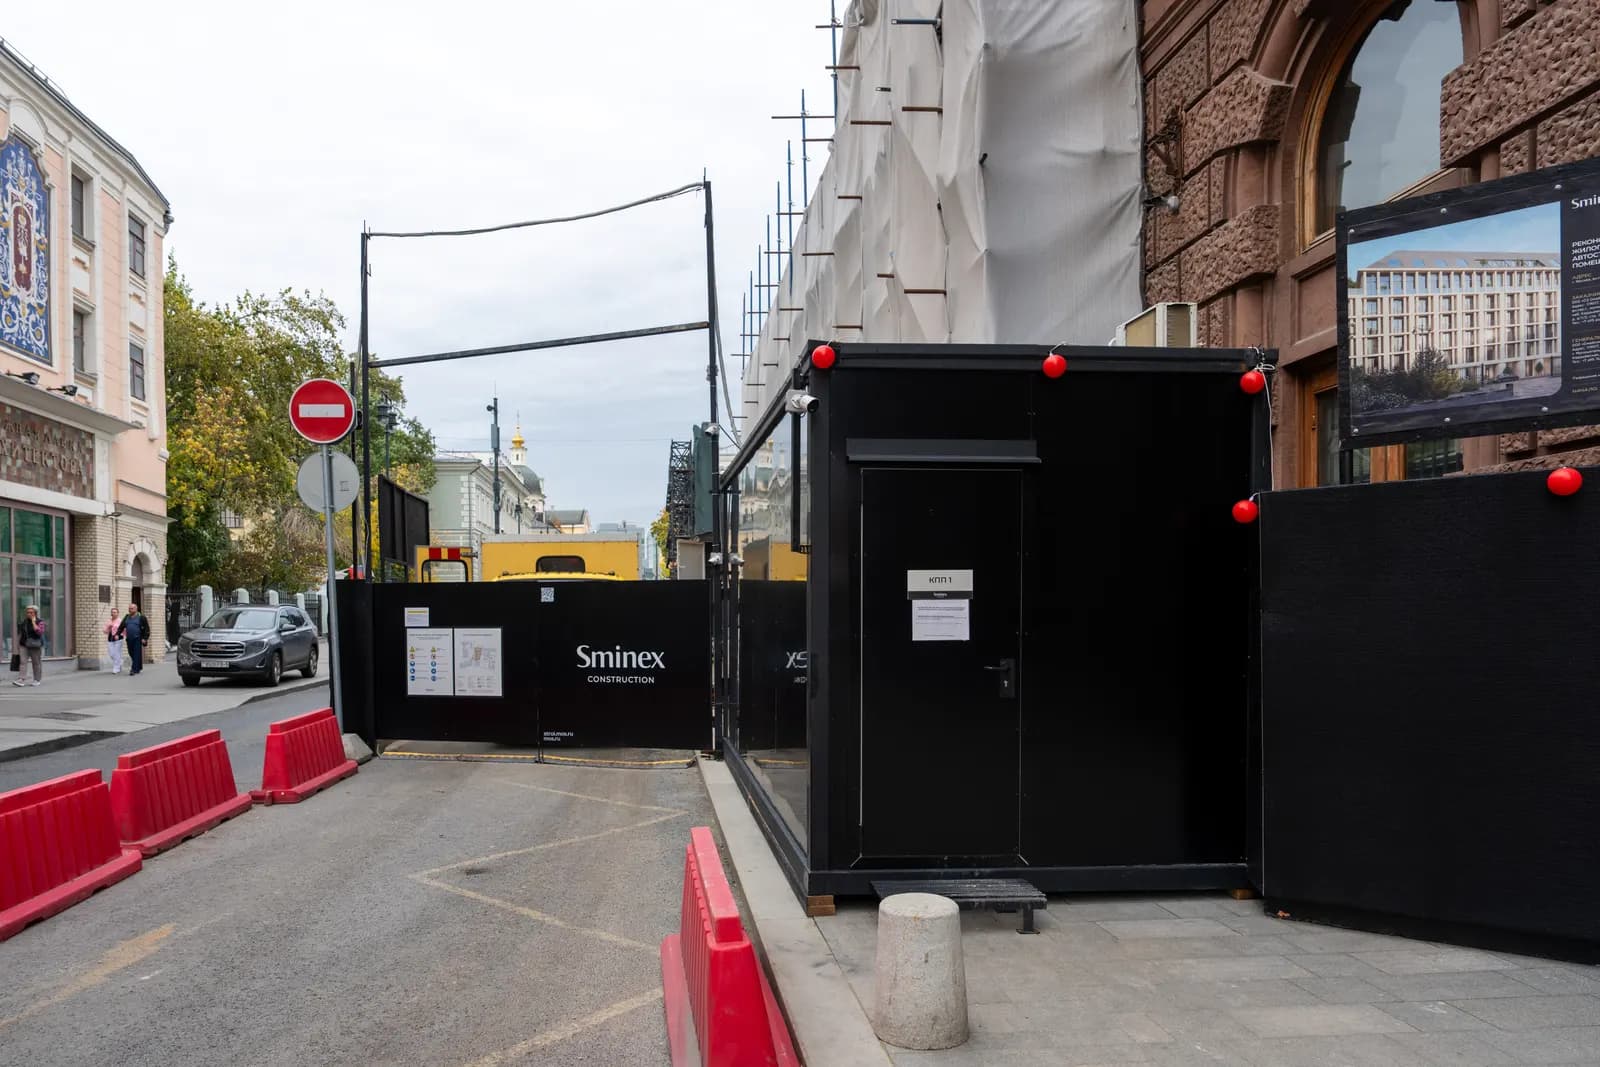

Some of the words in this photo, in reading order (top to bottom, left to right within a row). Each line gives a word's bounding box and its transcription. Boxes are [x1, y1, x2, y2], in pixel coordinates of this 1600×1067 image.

[1572, 238, 1600, 248] РЕКОН
[1572, 251, 1600, 262] АВТОС
[577, 645, 666, 668] Sminex
[587, 675, 655, 684] CONSTRUCTION
